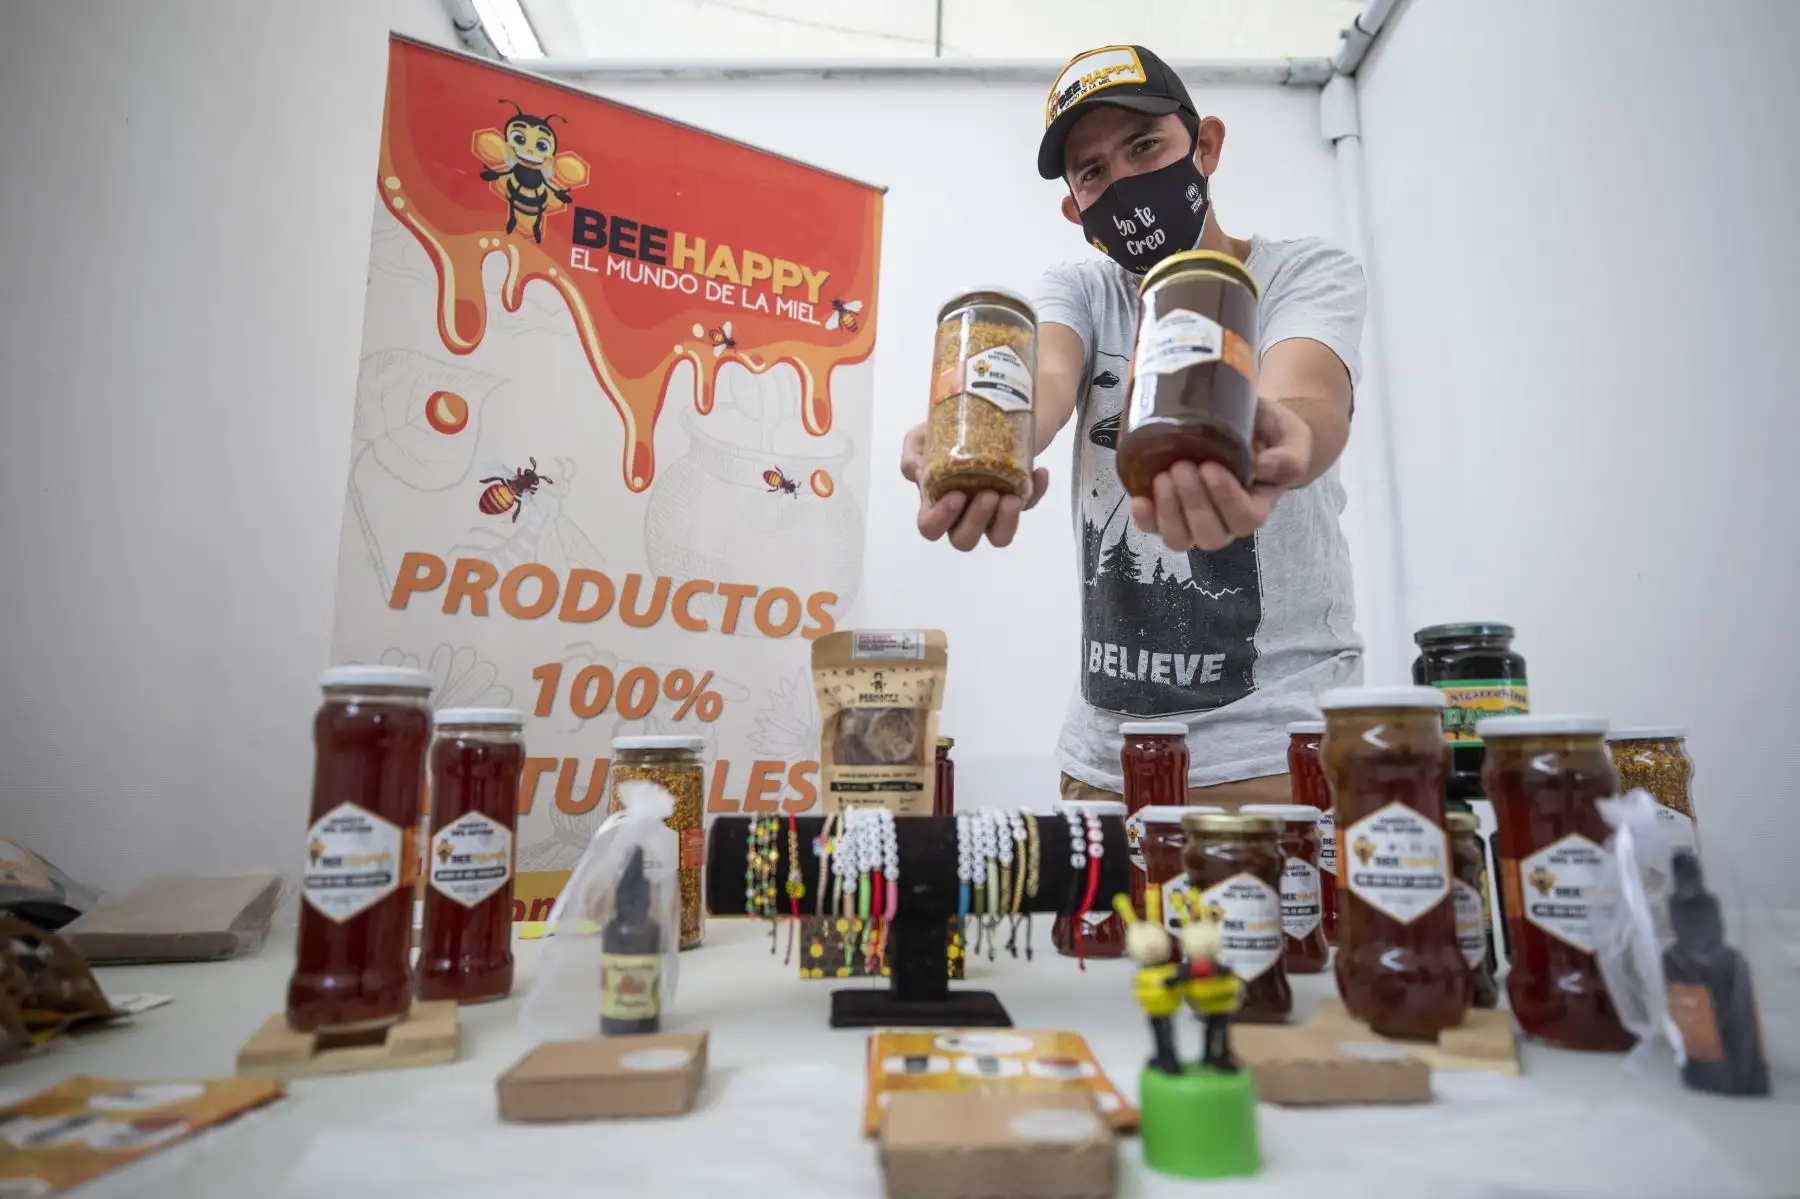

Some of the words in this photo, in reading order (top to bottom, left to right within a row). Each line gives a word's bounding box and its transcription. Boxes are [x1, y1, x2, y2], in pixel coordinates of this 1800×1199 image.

[1126, 228, 1166, 256] creo
[1134, 206, 1156, 228] te
[570, 247, 599, 273] EL
[606, 255, 698, 294] MUNDO
[705, 280, 735, 305] DE
[742, 288, 769, 313] LA
[776, 297, 821, 326] MIEL
[388, 552, 838, 640] PRODUCTOS
[1088, 640, 1226, 687] BELIEVE
[532, 662, 724, 722] 100%
